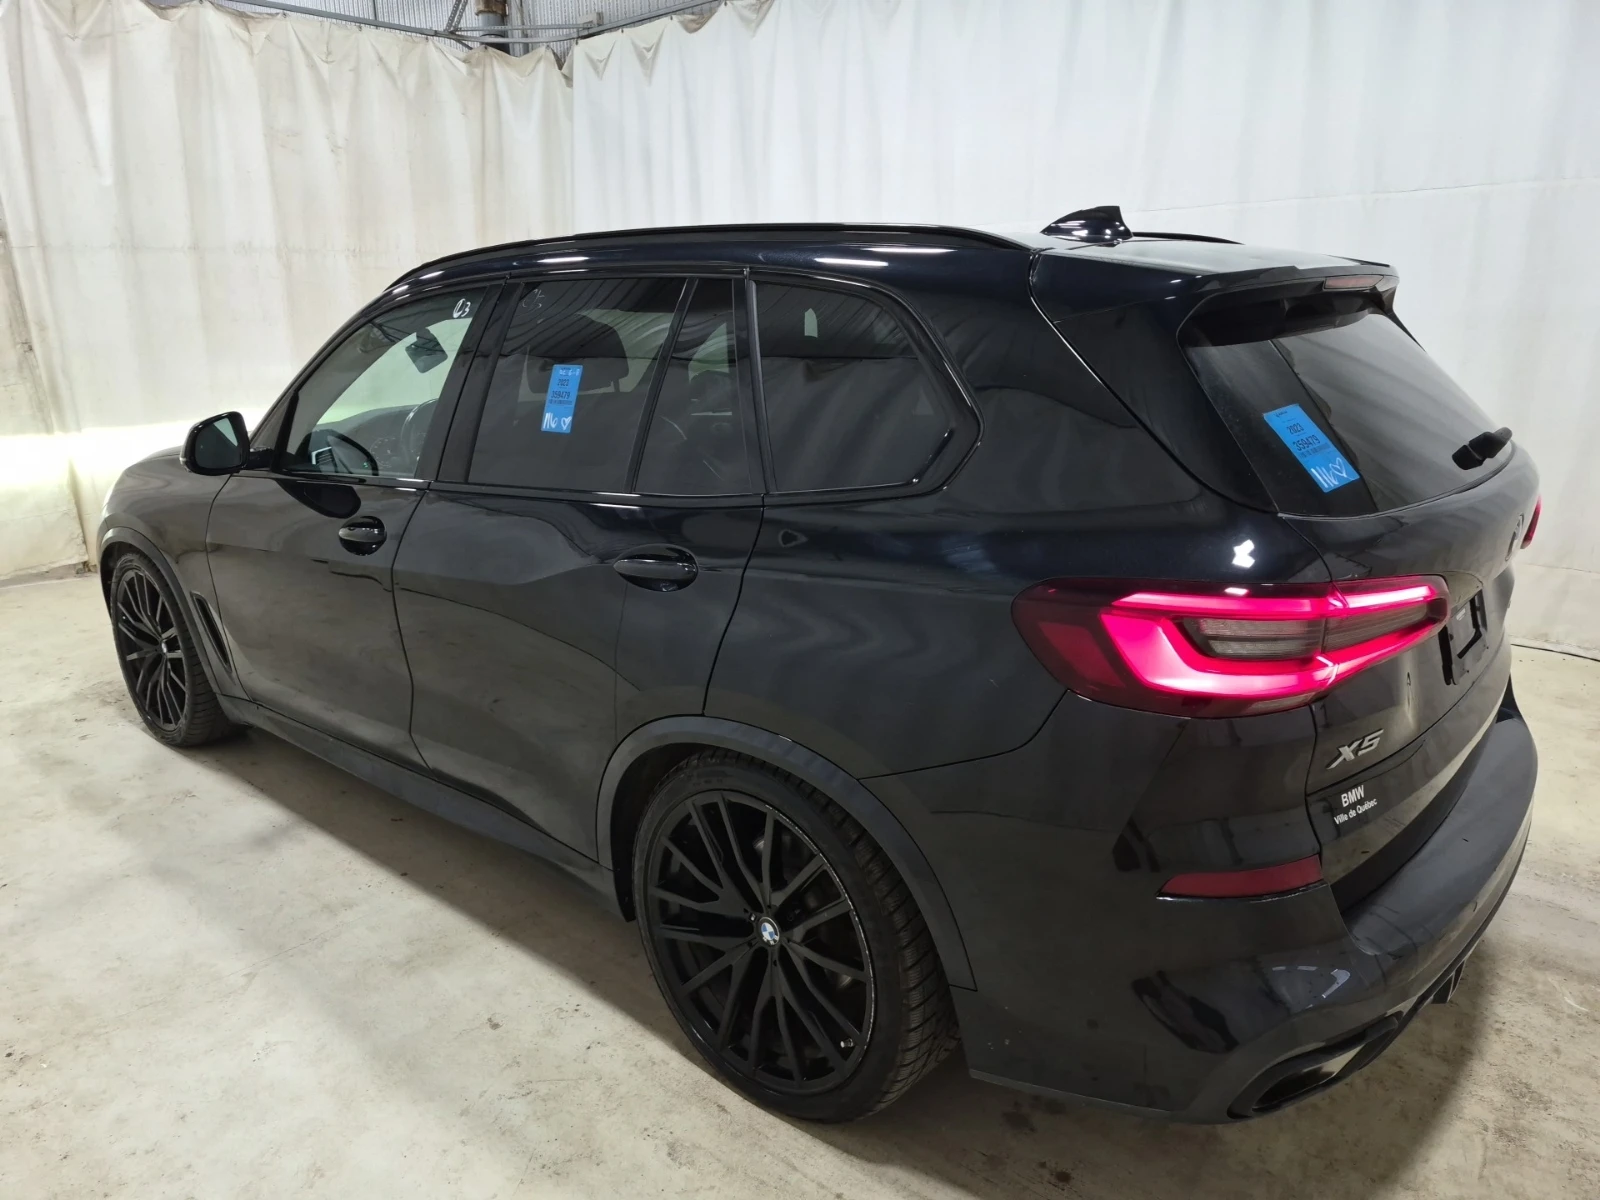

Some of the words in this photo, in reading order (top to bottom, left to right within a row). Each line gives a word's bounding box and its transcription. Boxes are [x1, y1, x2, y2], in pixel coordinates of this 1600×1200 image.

[1286, 422, 1305, 435] 2023
[1292, 434, 1321, 452] 359479
[1325, 728, 1384, 770] X5
[1340, 784, 1365, 808] BMW
[1333, 813, 1349, 825] Ville
[1348, 809, 1357, 819] de
[1356, 798, 1378, 815] Québec
